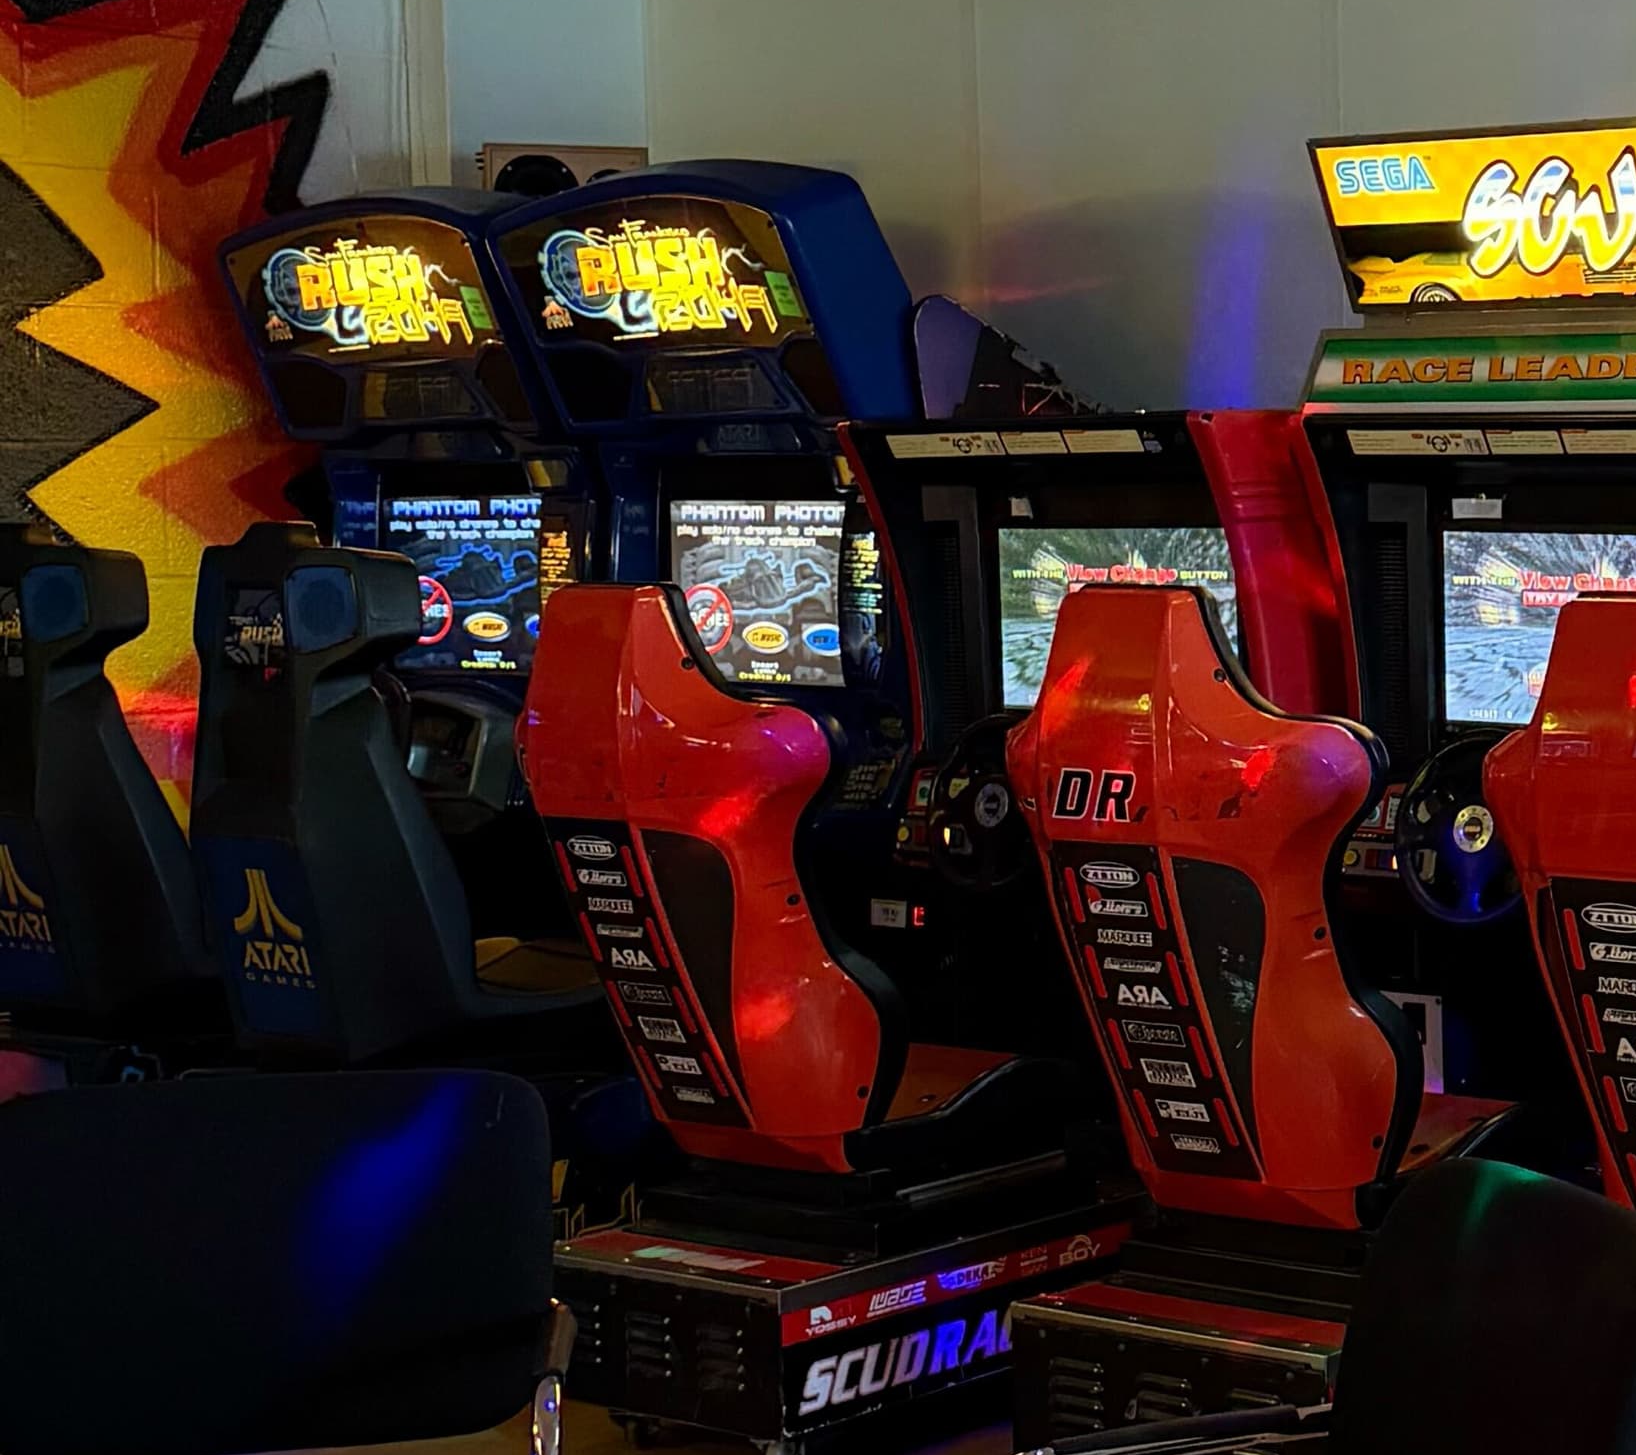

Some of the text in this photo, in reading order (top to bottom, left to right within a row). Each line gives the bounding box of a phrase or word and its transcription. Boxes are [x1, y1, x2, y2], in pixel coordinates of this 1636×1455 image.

[1335, 156, 1436, 194] SEGA
[576, 237, 725, 297] RUSH
[297, 254, 430, 310] RUSH
[1342, 356, 1476, 385] RACE
[392, 499, 481, 516] PHANTOM
[681, 505, 766, 521] PHANTOM
[1067, 564, 1109, 583] View
[1519, 572, 1571, 591] View
[1052, 767, 1136, 822] DR
[244, 941, 311, 976] ATARI
[1058, 1243, 1101, 1266] BOY
